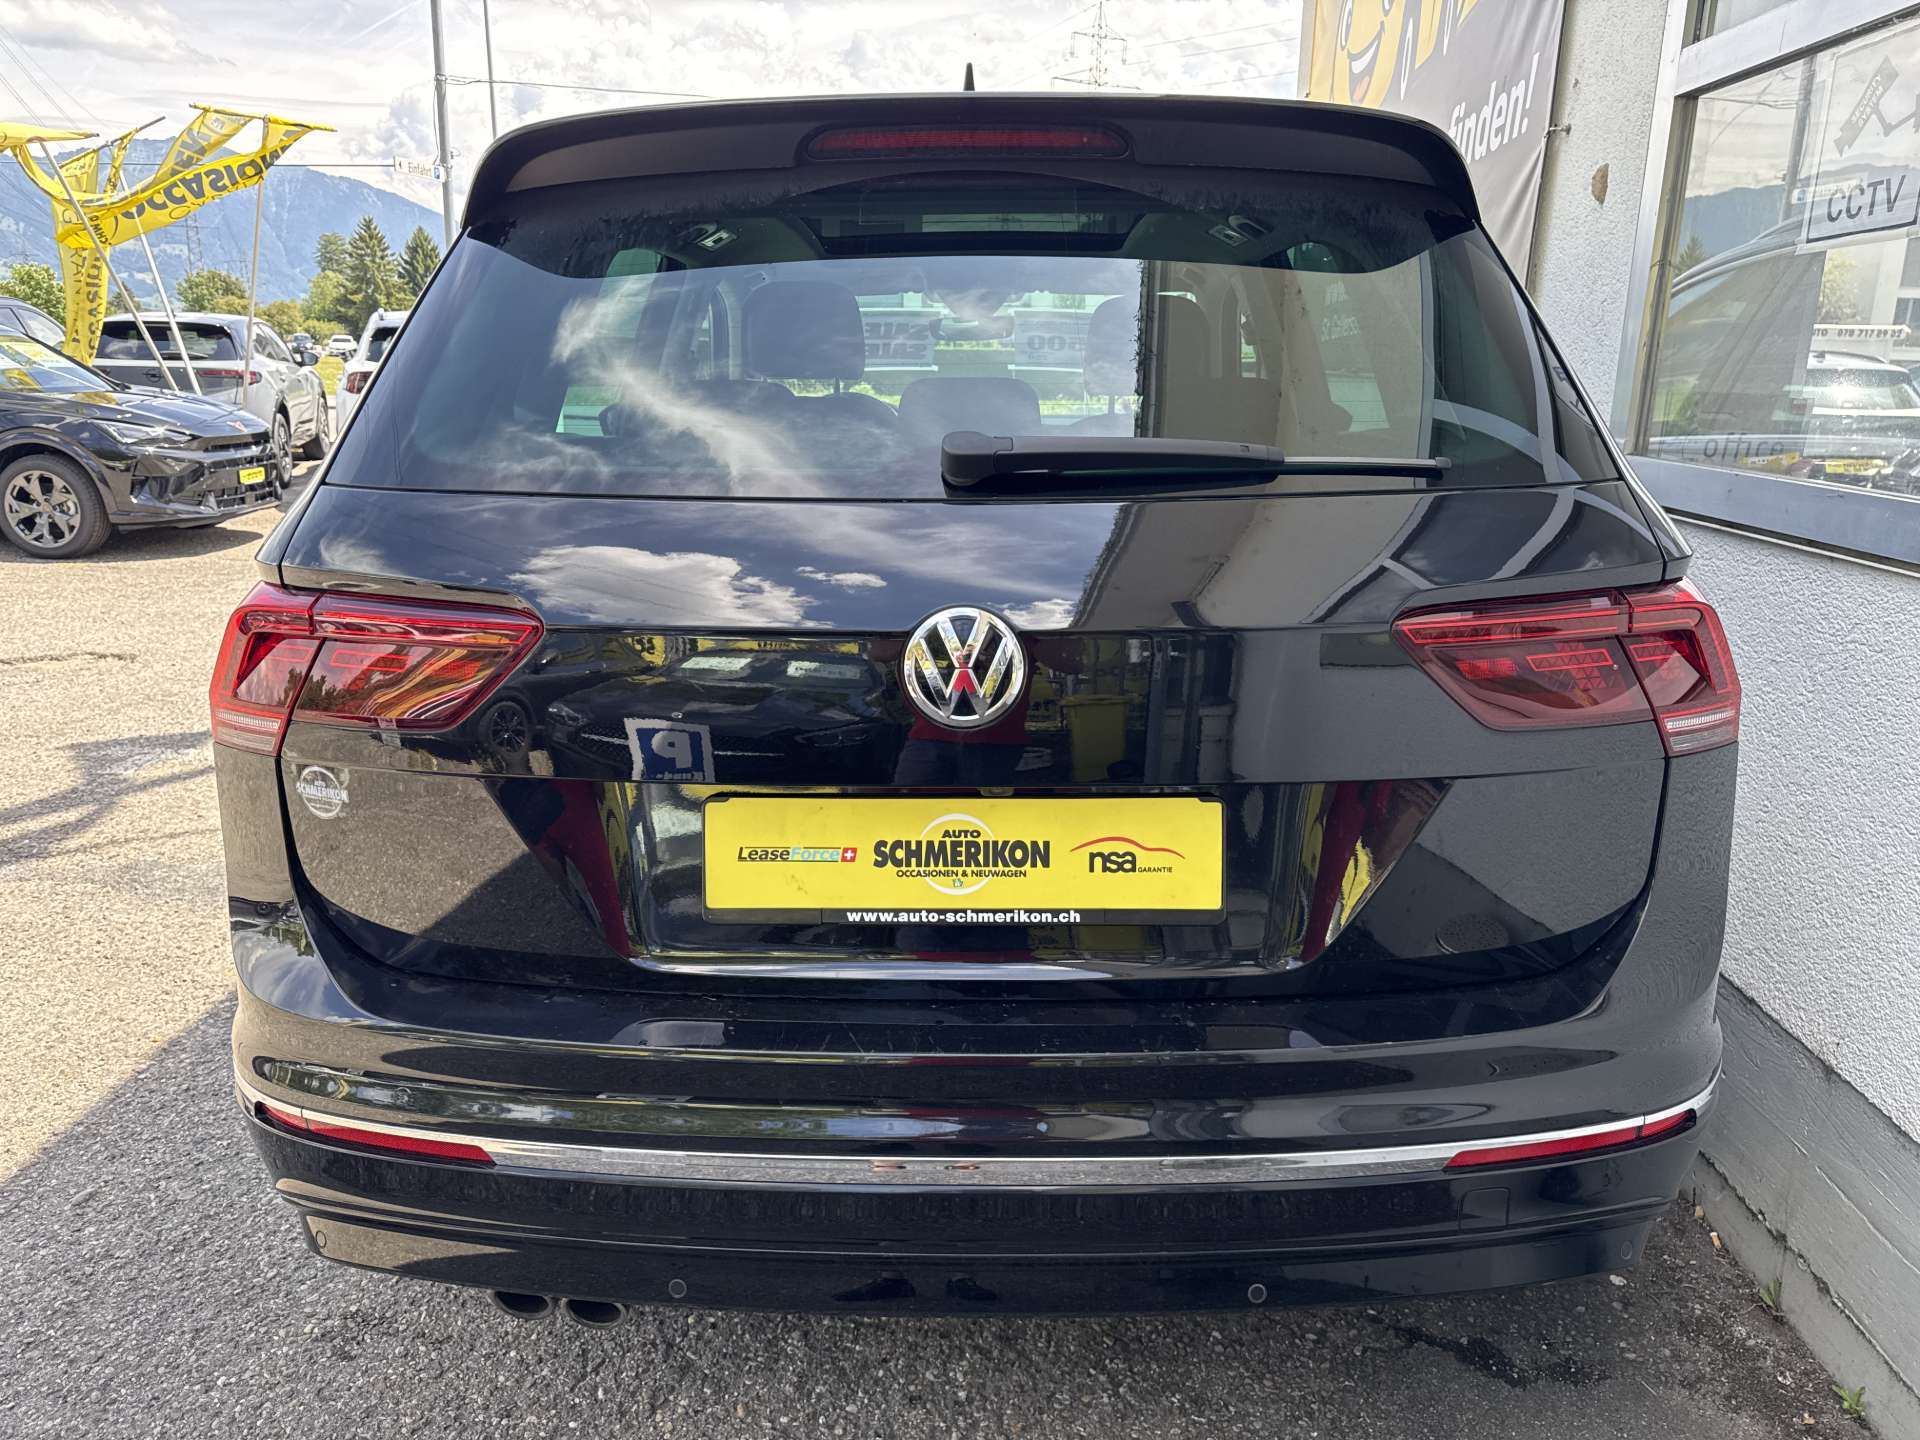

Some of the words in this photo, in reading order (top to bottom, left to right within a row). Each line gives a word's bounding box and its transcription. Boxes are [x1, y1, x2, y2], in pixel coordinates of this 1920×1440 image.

[1449, 51, 1540, 165] finden!
[1826, 174, 1906, 223] CCTV
[1702, 431, 1786, 461] office
[295, 782, 349, 803] SCHMERIKON
[942, 829, 981, 839] AUTO
[737, 846, 840, 862] LeaseForce
[873, 840, 1050, 869] SCHMERIKON
[1089, 851, 1136, 874] nsa
[896, 869, 959, 878] OCCASIONEN
[961, 869, 968, 878] &
[971, 869, 1027, 878] NEUWAGEN
[847, 909, 1081, 923] www.auto-schmerikon.ch
